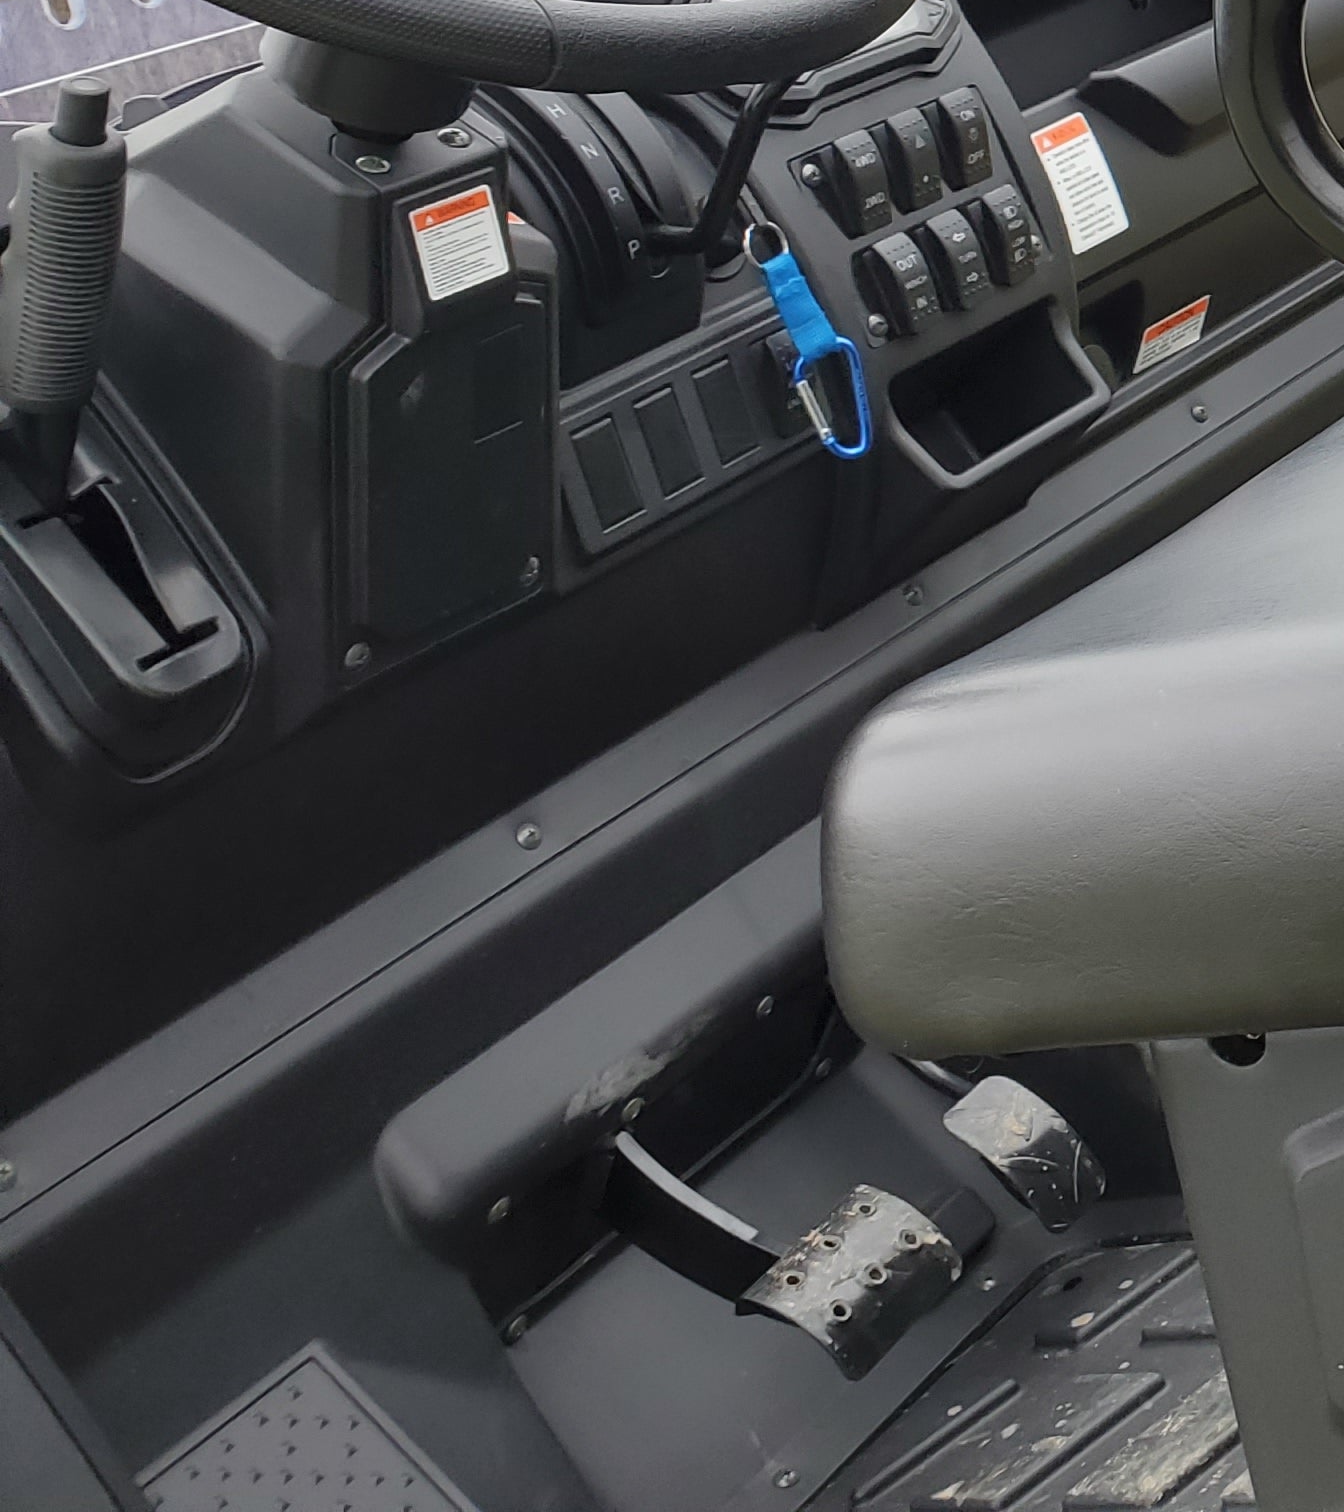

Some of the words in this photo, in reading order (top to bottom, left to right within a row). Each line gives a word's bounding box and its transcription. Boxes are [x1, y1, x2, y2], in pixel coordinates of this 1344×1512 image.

[545, 103, 567, 119] H
[580, 142, 600, 159] N
[607, 186, 625, 205] R
[627, 239, 641, 260] P
[896, 253, 919, 272] OUT
